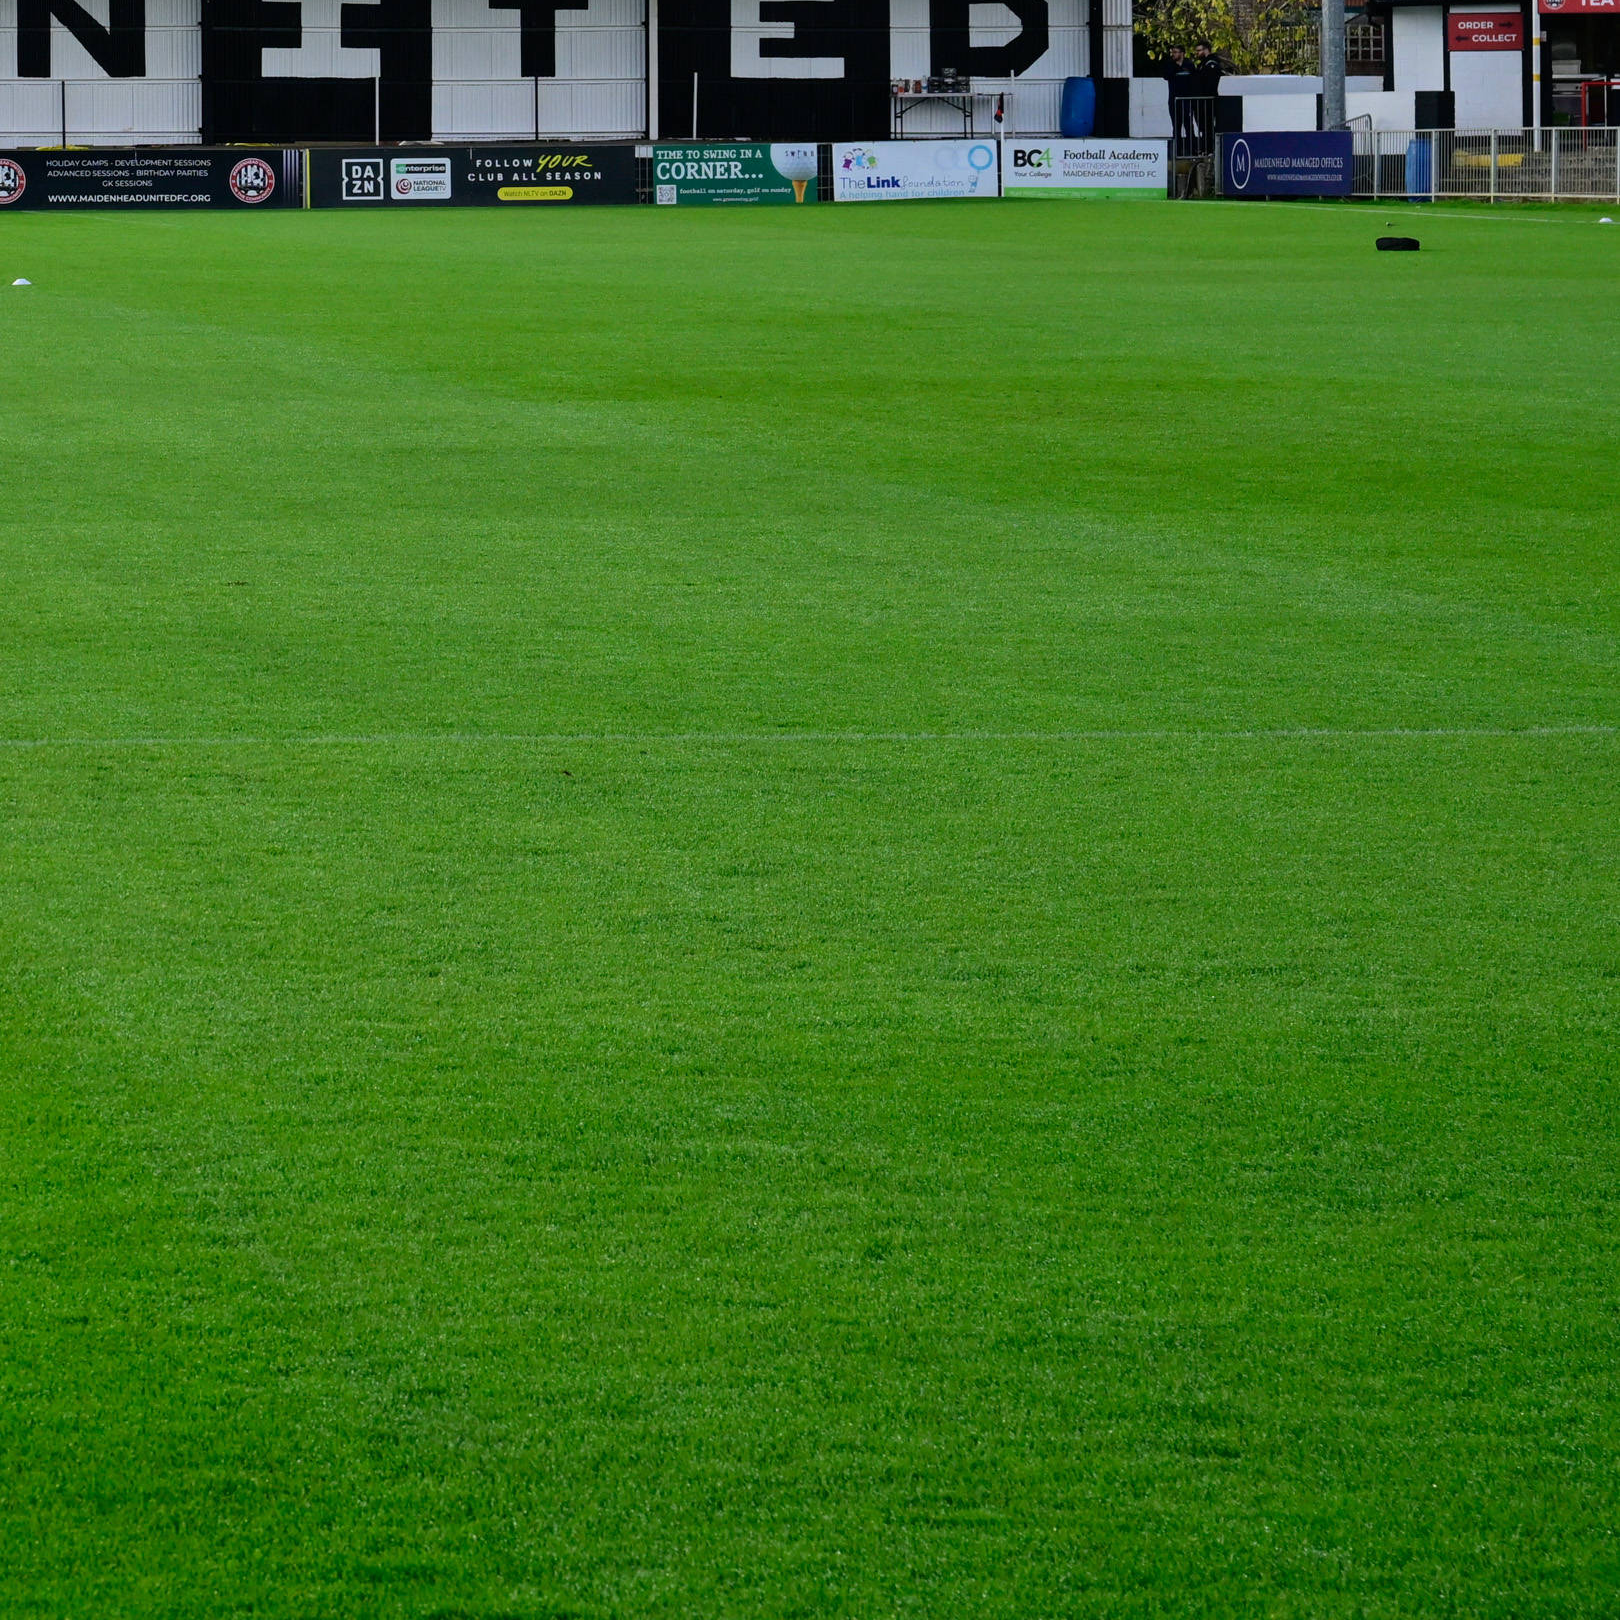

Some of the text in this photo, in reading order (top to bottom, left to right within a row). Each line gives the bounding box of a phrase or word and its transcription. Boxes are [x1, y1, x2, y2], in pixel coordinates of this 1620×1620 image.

[1457, 21, 1494, 29] ORDER
[1471, 34, 1517, 42] COLLECT
[656, 149, 763, 160] TIME TO SWING IN A
[1013, 147, 1053, 168] BCA
[1063, 149, 1159, 163] Football Academy
[114, 159, 173, 167] DEVELOPMENT
[174, 159, 212, 167] SESSIONS
[476, 154, 593, 173] FOLLOW YOUR
[1072, 162, 1120, 170] PARTNERSHIP
[1236, 154, 1246, 172] M
[1254, 157, 1344, 168] MAIDENHEAD MANAGED OFFICES
[176, 169, 209, 177] PARTIES
[467, 171, 602, 182] CLUB ALL SEASON
[656, 162, 764, 180] CORNER...
[1063, 170, 1157, 178] MAIDENHEAD UNITED FC
[48, 194, 211, 203] WWW.MAIDENHEADUNITEDFC.ORG
[848, 190, 883, 199] helping
[886, 190, 908, 198] hand
[927, 188, 965, 197] children
